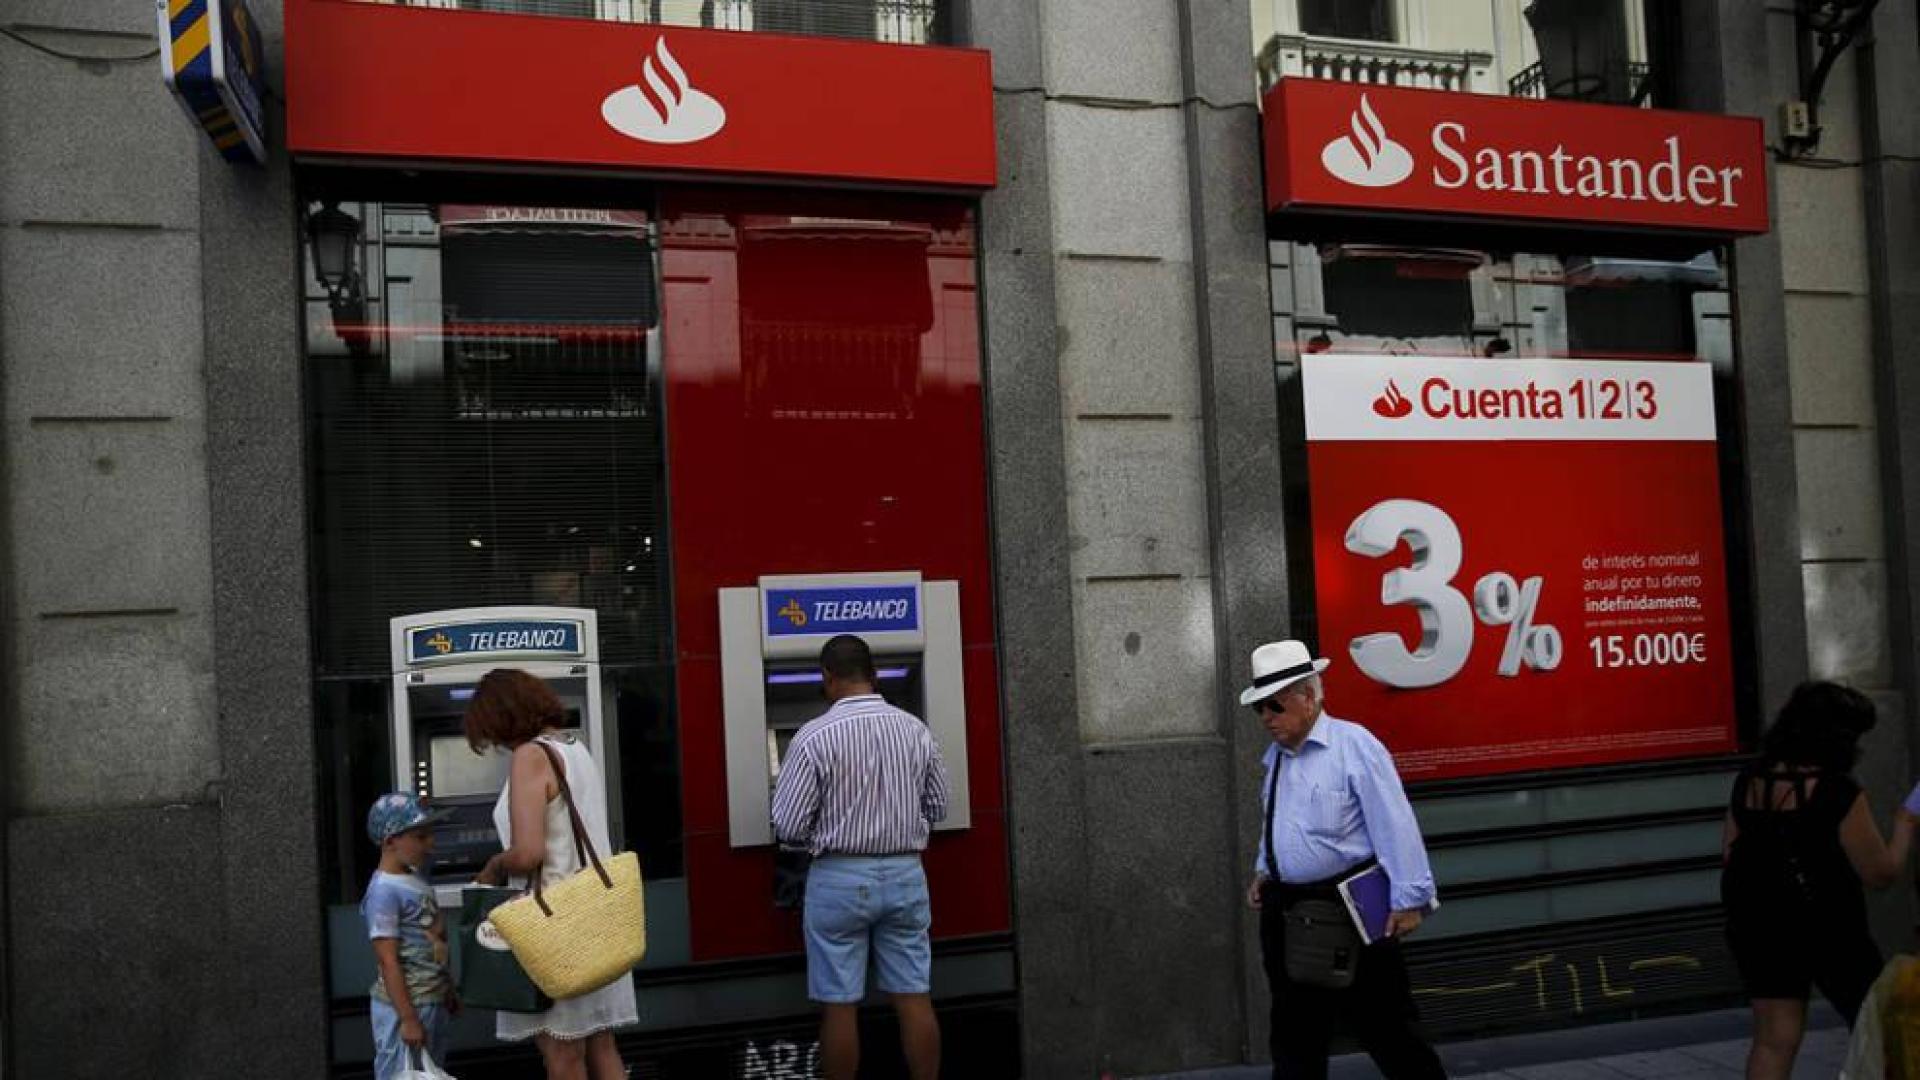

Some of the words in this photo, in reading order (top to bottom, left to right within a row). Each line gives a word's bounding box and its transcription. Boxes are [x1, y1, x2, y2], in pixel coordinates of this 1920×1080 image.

[1430, 121, 1743, 208] Santander
[1420, 377, 1563, 421] Cuenta
[1582, 555, 1599, 569] de
[1602, 553, 1646, 569] interés
[1648, 551, 1700, 568] nominal
[1344, 498, 1562, 689] 3%
[1583, 575, 1618, 591] anual
[1621, 577, 1642, 592] por
[1646, 576, 1660, 588] tu
[1661, 573, 1702, 588] dinero
[813, 598, 908, 622] TELEBANCO
[468, 627, 566, 651] TELEBANCO
[1589, 631, 1707, 668] 15.000€
